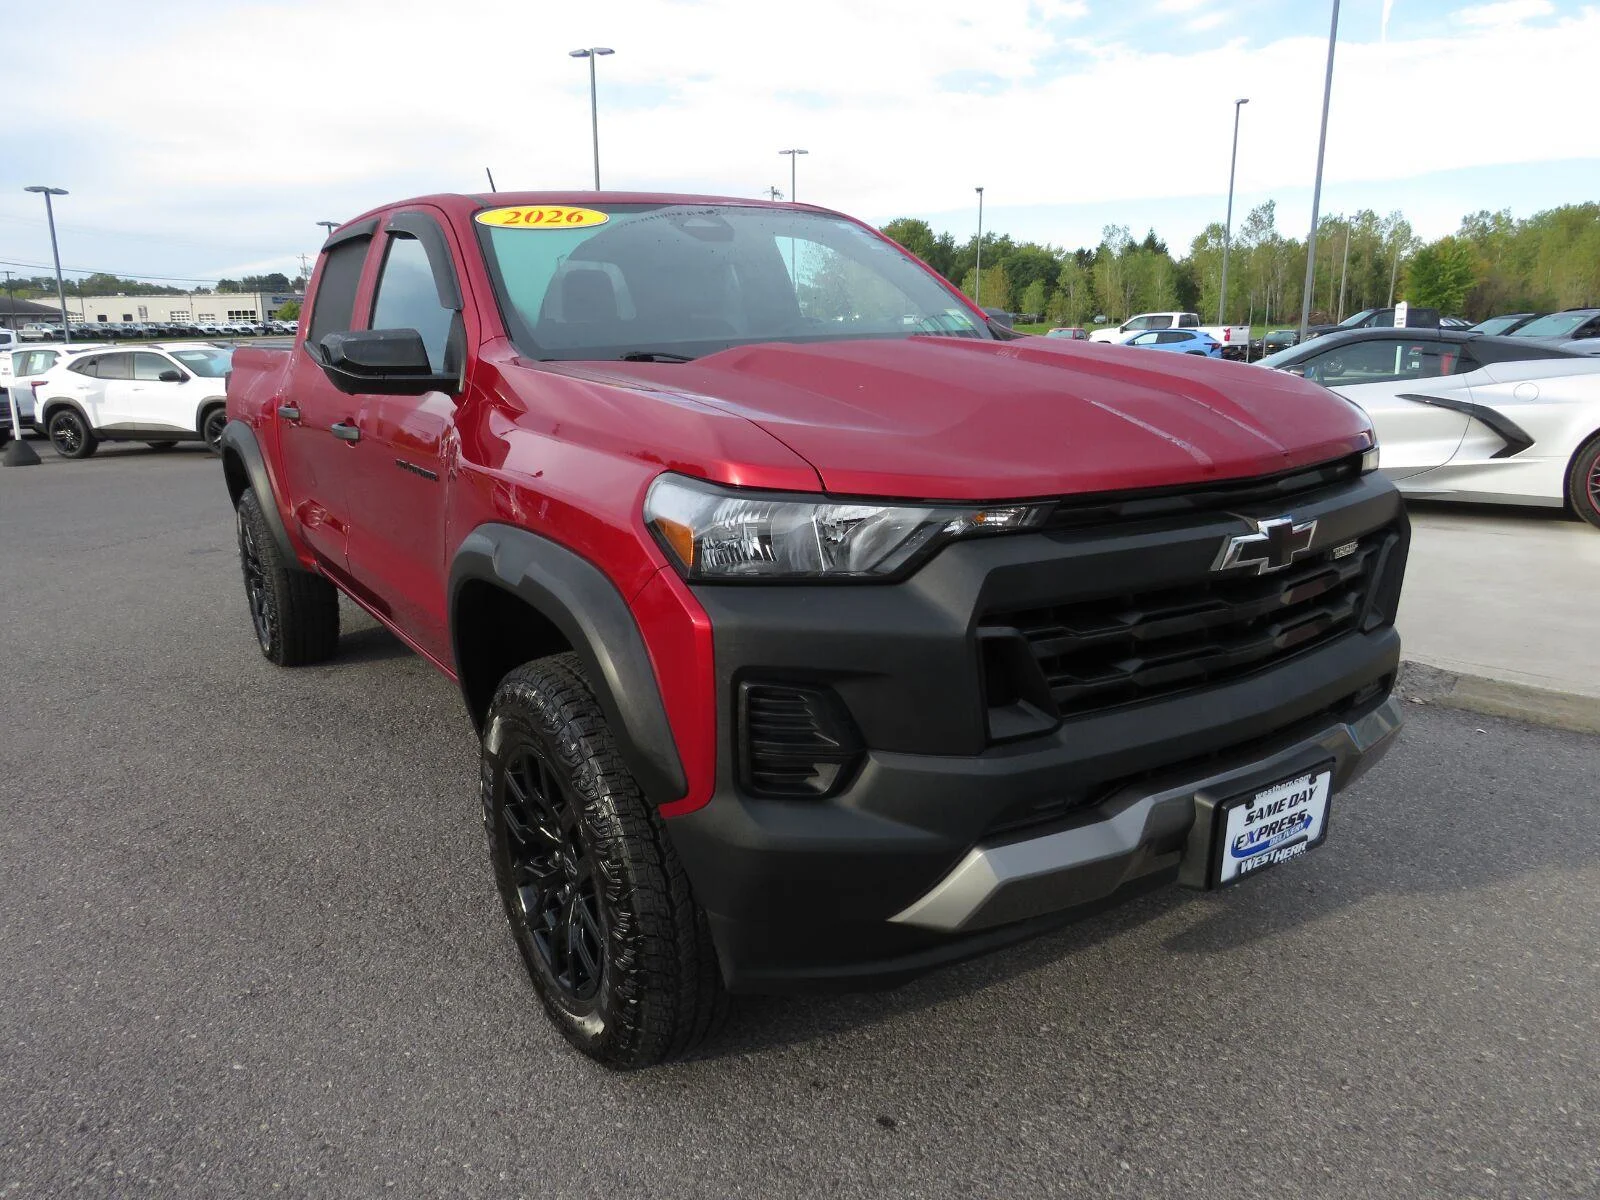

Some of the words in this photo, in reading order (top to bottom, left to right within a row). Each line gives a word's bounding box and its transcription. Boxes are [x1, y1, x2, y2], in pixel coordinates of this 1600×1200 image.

[503, 210, 584, 225] 2026
[1244, 797, 1287, 827] SAME
[1287, 785, 1318, 809] DAY
[1235, 808, 1308, 850] EXPRESS
